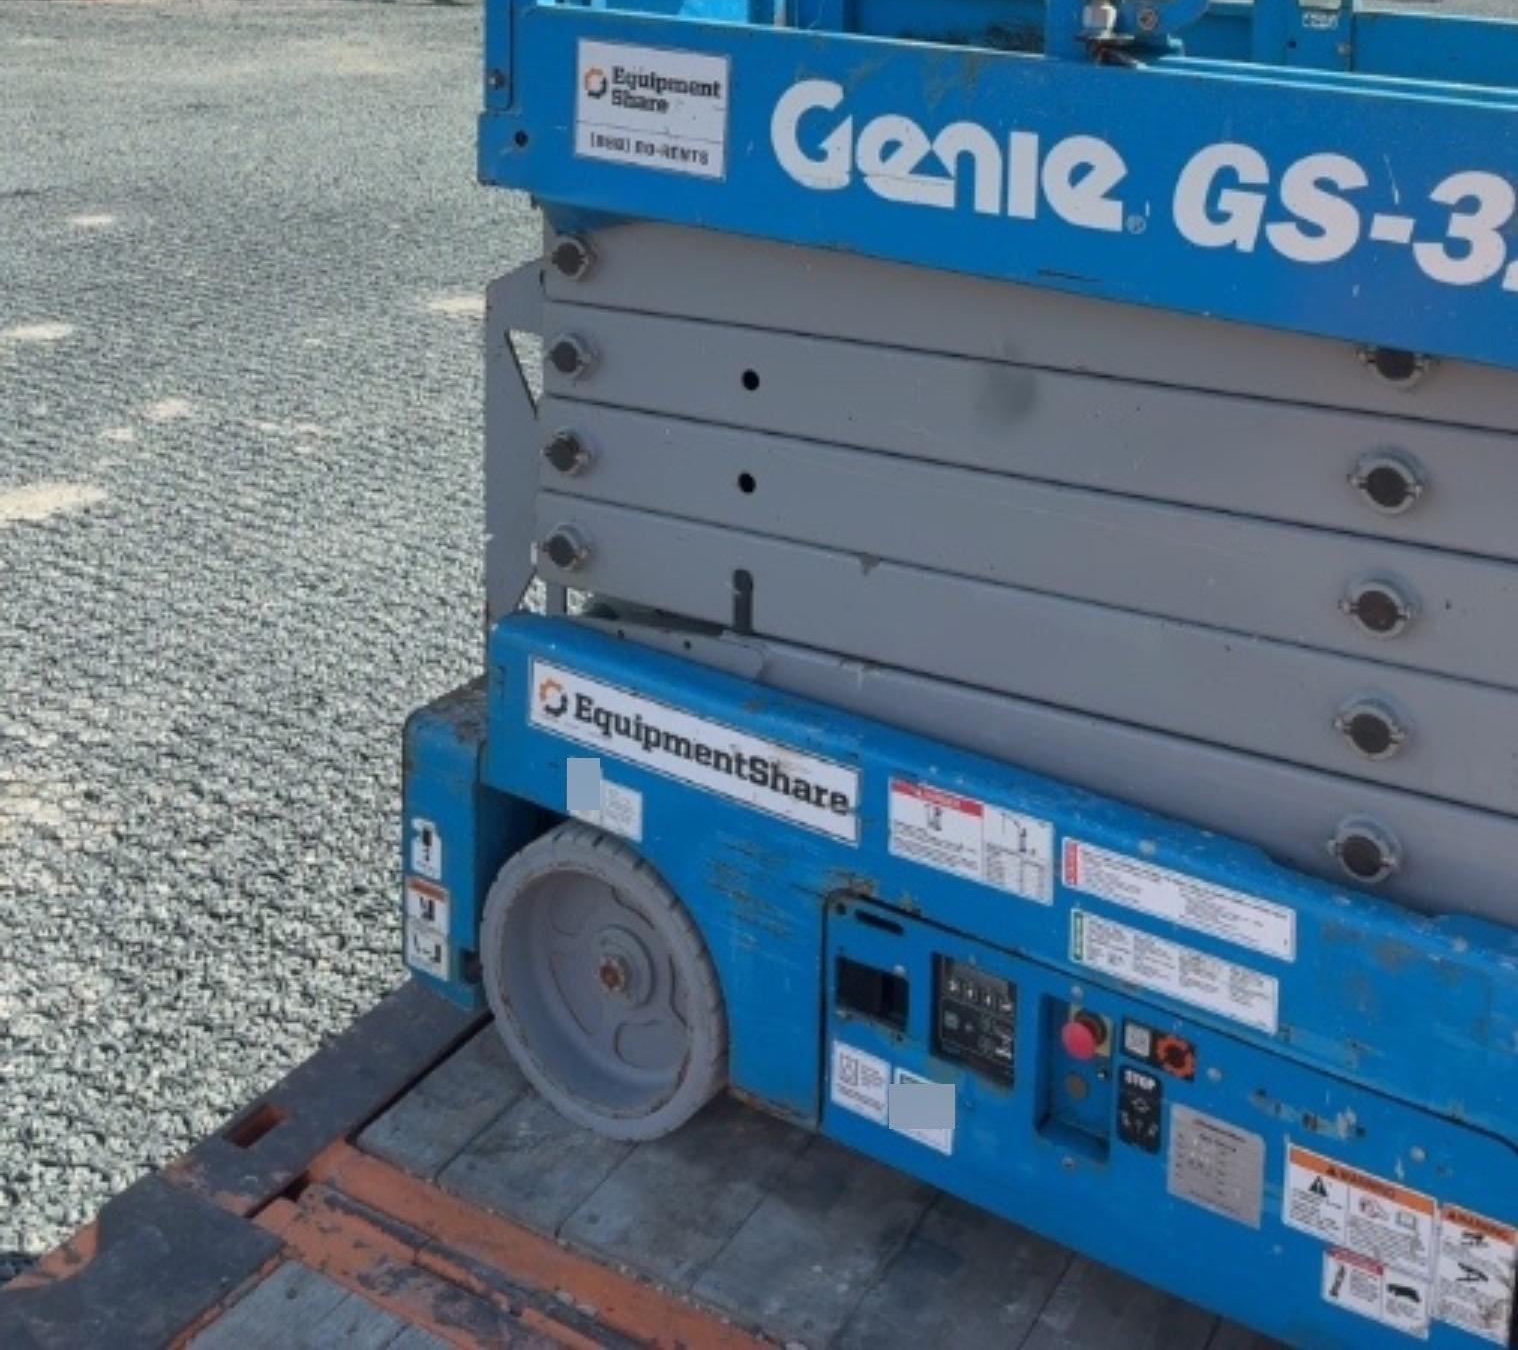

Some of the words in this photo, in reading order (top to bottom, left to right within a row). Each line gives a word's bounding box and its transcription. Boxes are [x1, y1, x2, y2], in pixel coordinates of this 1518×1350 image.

[612, 66, 720, 98] Equipment
[611, 89, 669, 114] Share
[574, 692, 850, 815] EquipmentShare
